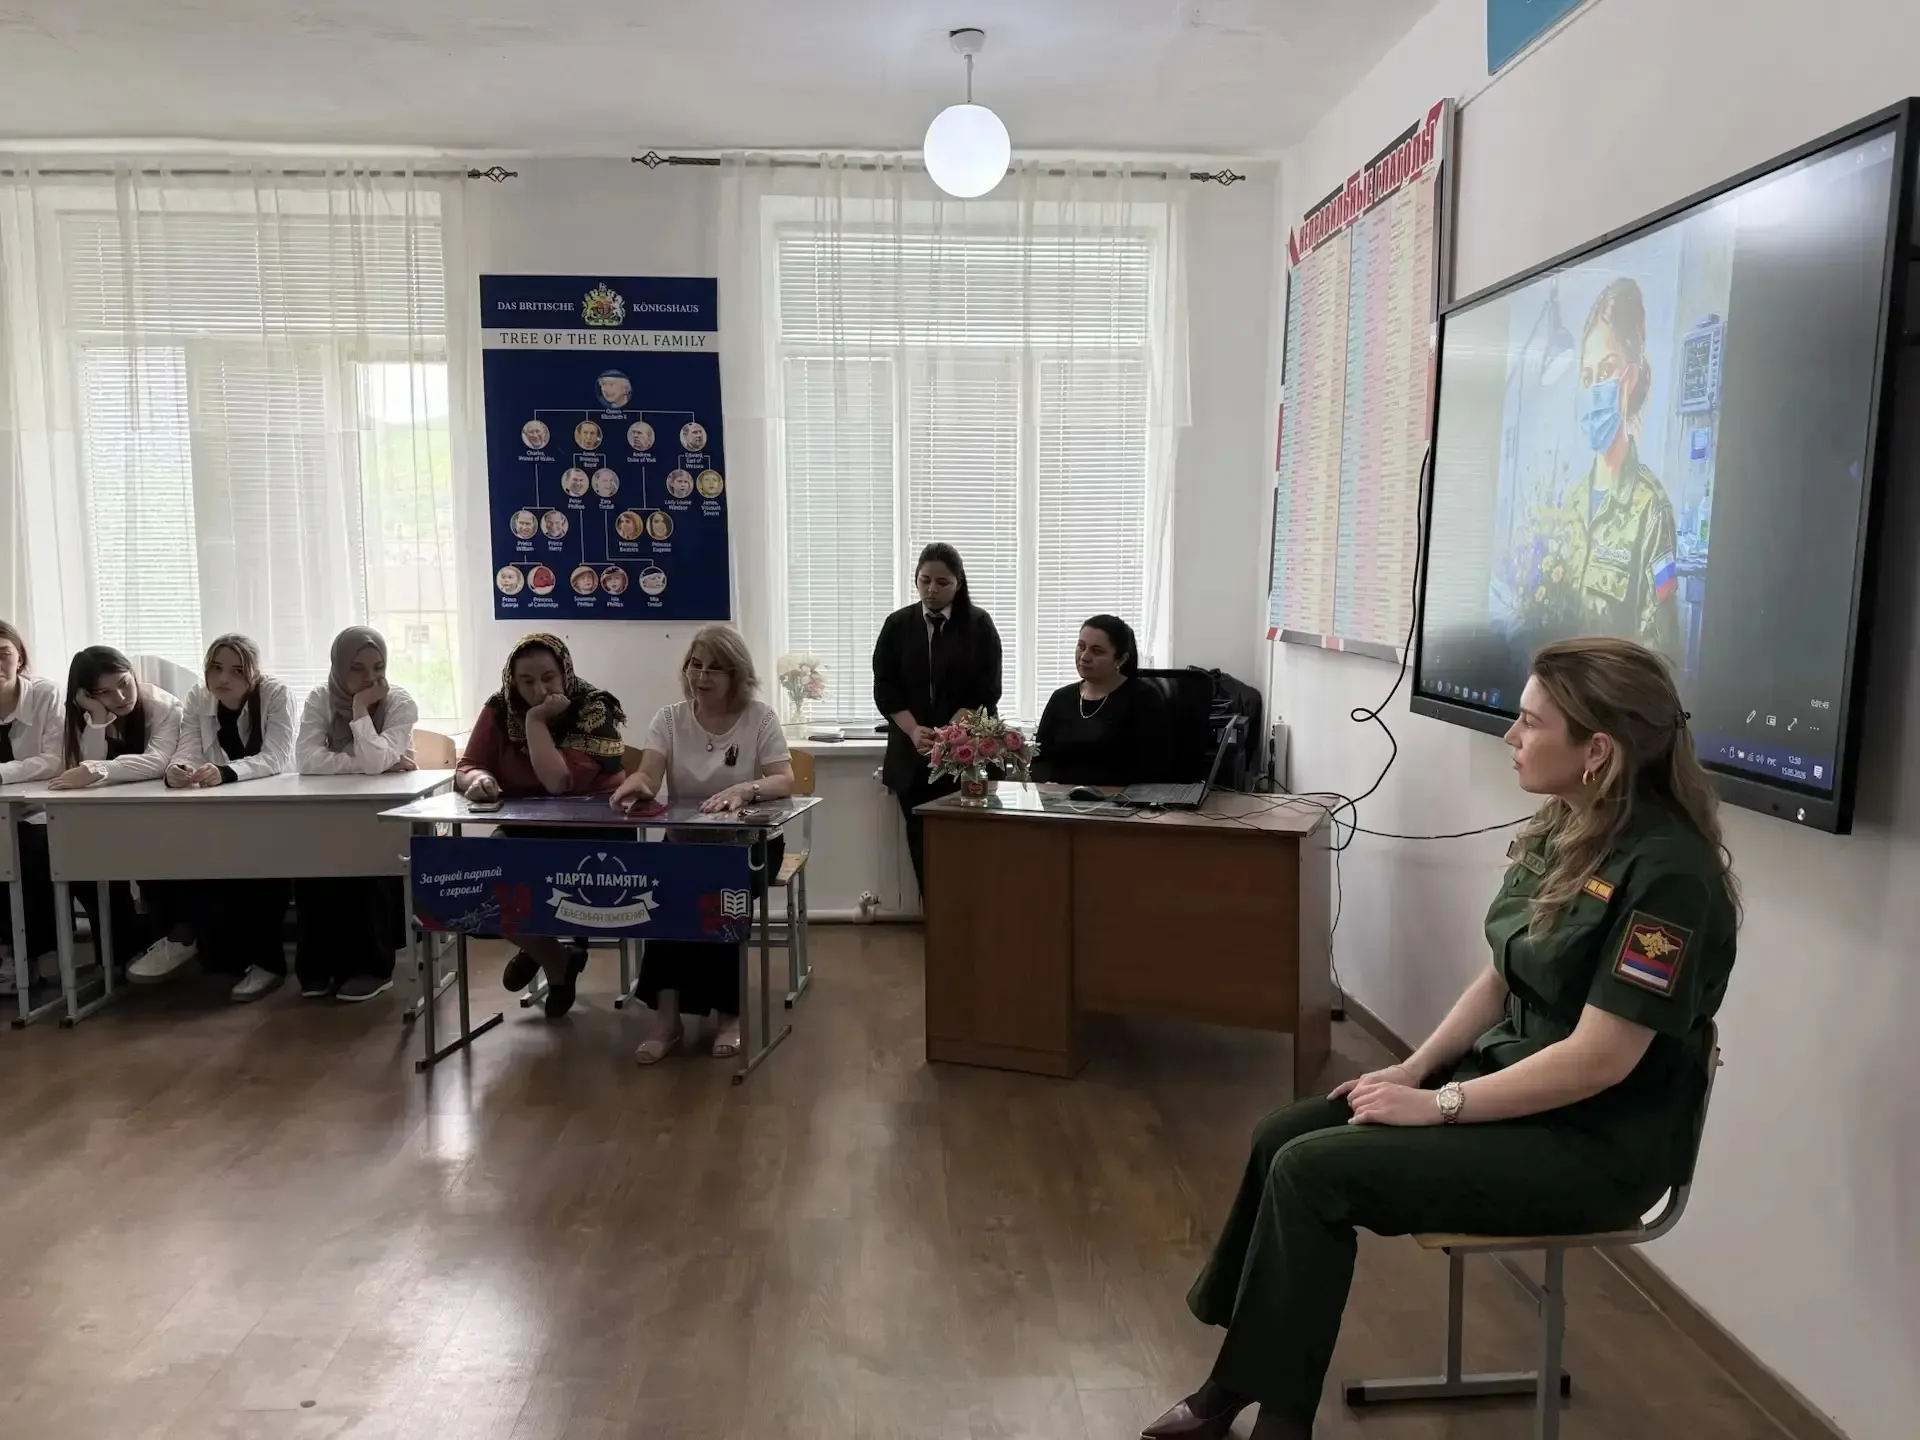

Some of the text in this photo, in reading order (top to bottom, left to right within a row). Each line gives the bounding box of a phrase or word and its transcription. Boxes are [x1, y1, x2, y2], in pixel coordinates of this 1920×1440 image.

[1299, 120, 1435, 256] НЕПРАВИЛЬНЫЕ ГЛАГОЛЫ
[497, 301, 699, 313] DAS BRITISCHE KÖNIGSHAUS
[500, 332, 705, 347] TREE OF THE ROYAL FAMILY
[420, 866, 503, 885] За одной партой
[556, 872, 647, 887] ПАРТА ПАМЯТИ
[439, 882, 483, 898] с героем!
